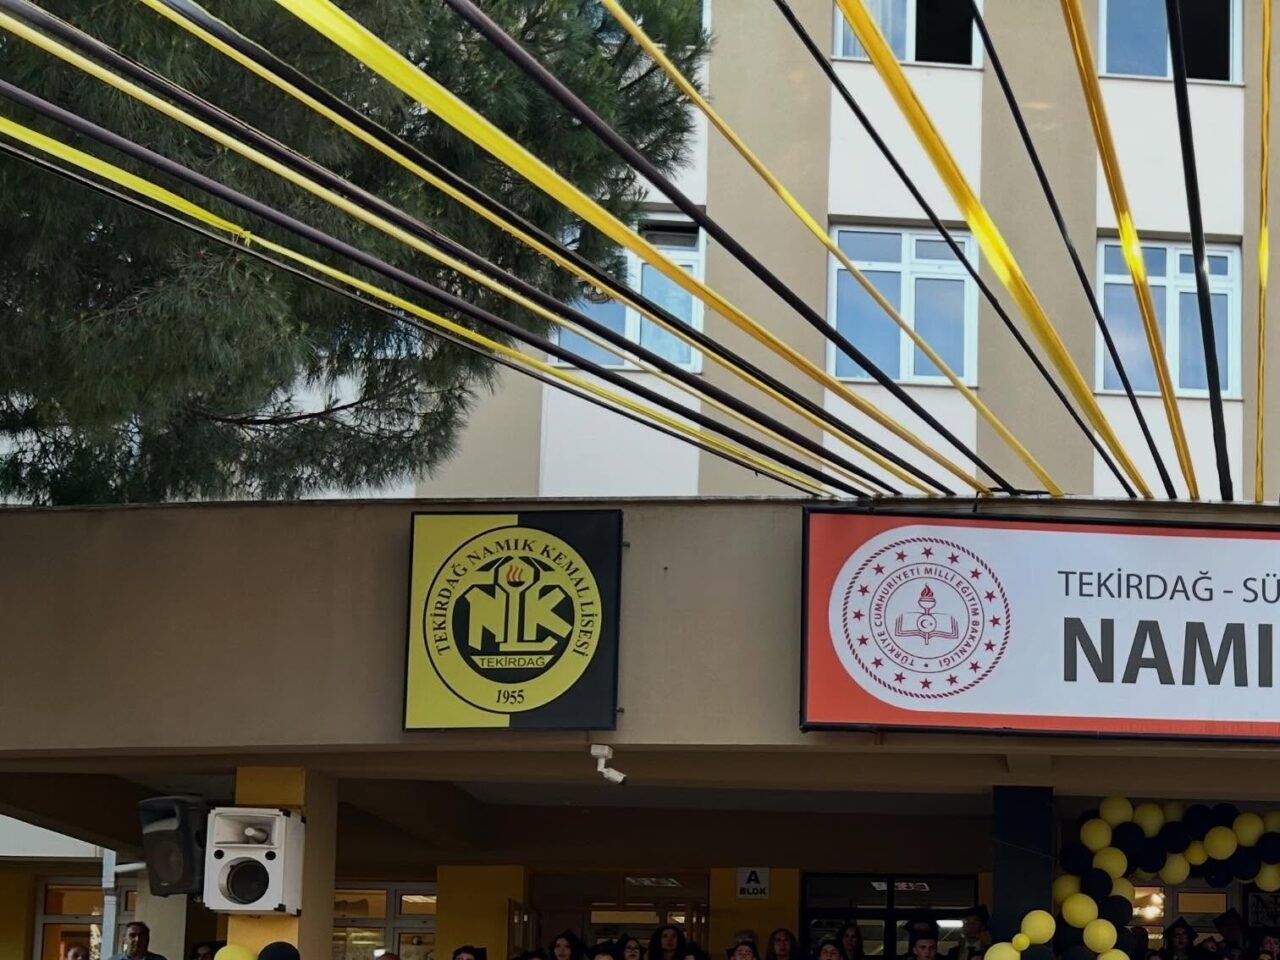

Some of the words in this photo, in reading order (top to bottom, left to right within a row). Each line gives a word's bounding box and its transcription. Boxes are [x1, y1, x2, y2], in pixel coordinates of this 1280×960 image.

[924, 567, 956, 582] MİLLİ
[1057, 567, 1214, 602] TEKİRDAĞ
[431, 563, 468, 656] TEKİRDAĞ
[466, 538, 537, 566] NAMIK
[540, 544, 585, 598] KEMAL
[572, 600, 599, 658] LİSESİ
[874, 567, 920, 627] CUMHURİYETİ
[955, 580, 979, 617] EĞİTİM
[877, 631, 914, 666] TÜRKİYE
[938, 620, 980, 667] BAKANLIĞI
[479, 656, 545, 668] TEKİRDAĞ
[496, 689, 525, 705] 1955
[746, 870, 760, 884] A
